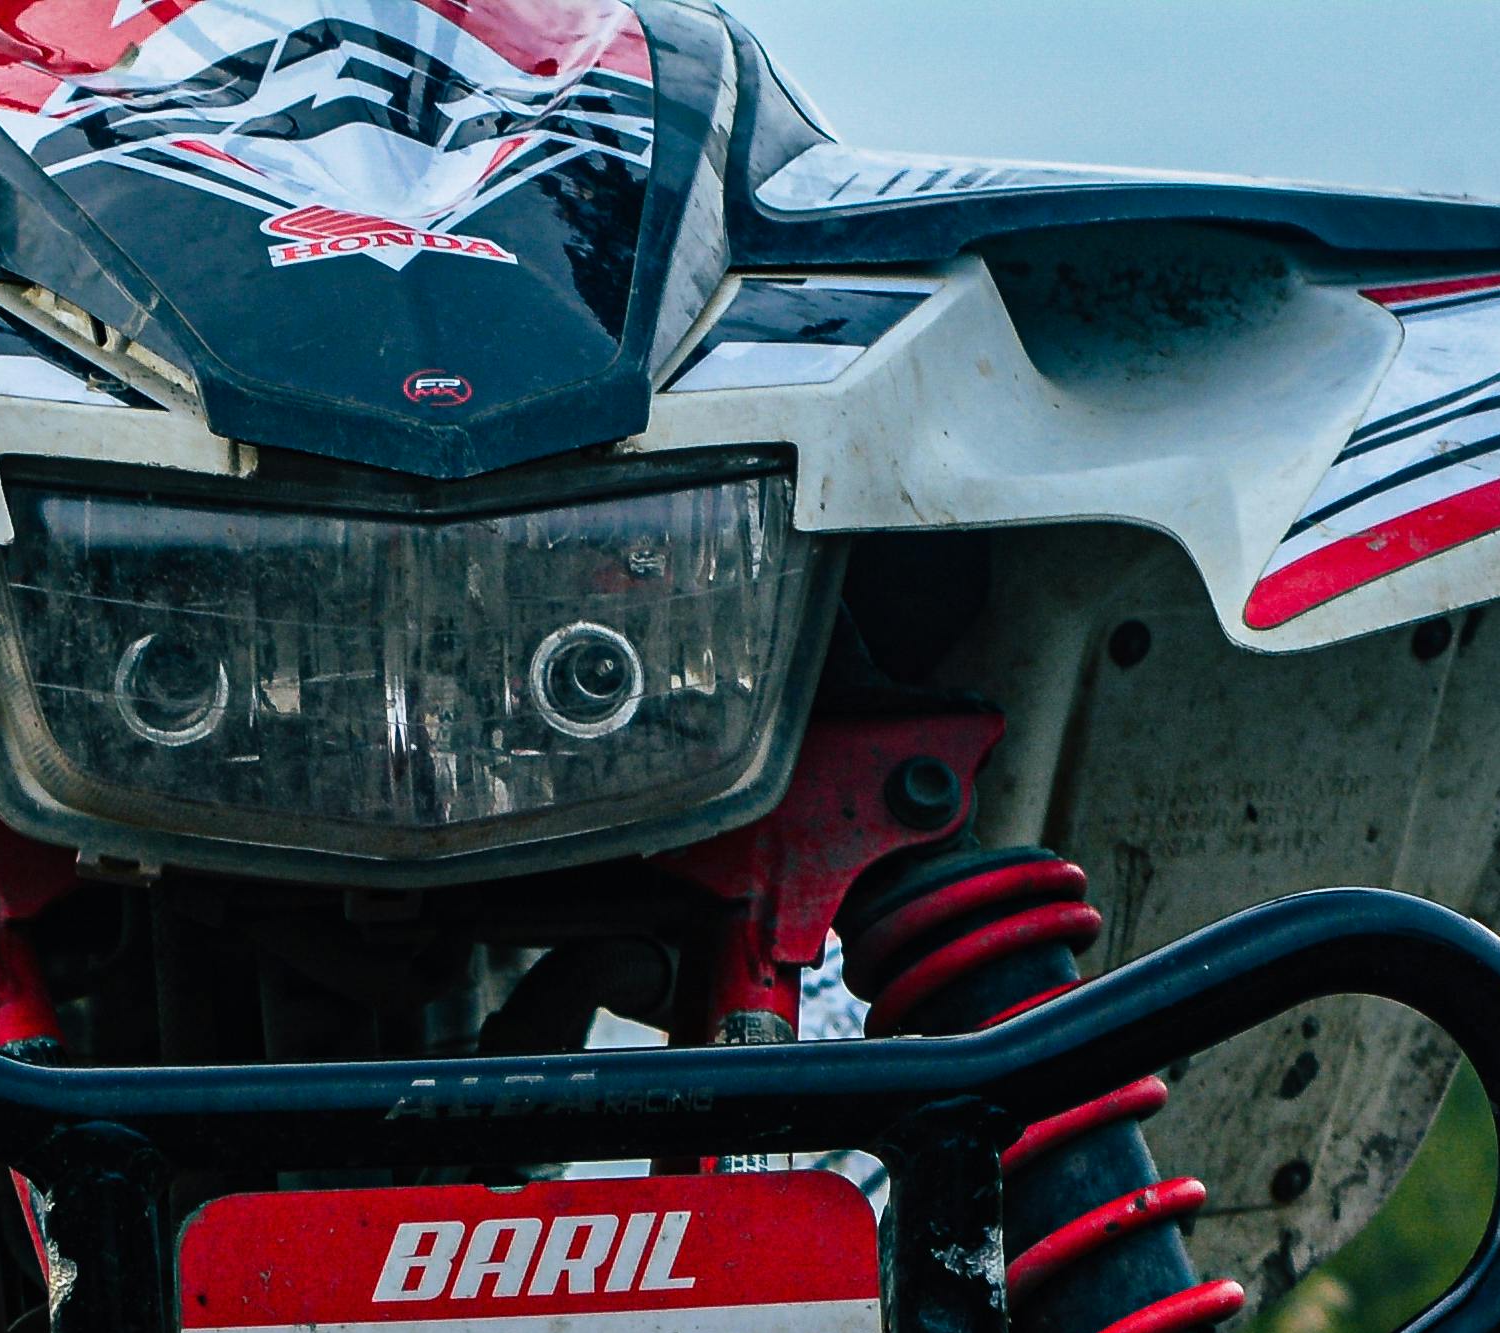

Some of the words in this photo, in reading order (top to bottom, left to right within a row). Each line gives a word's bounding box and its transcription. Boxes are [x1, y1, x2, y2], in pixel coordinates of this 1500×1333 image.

[280, 231, 509, 263] HONDA
[602, 1086, 715, 1115] RACING
[371, 1210, 697, 1304] BARIL
